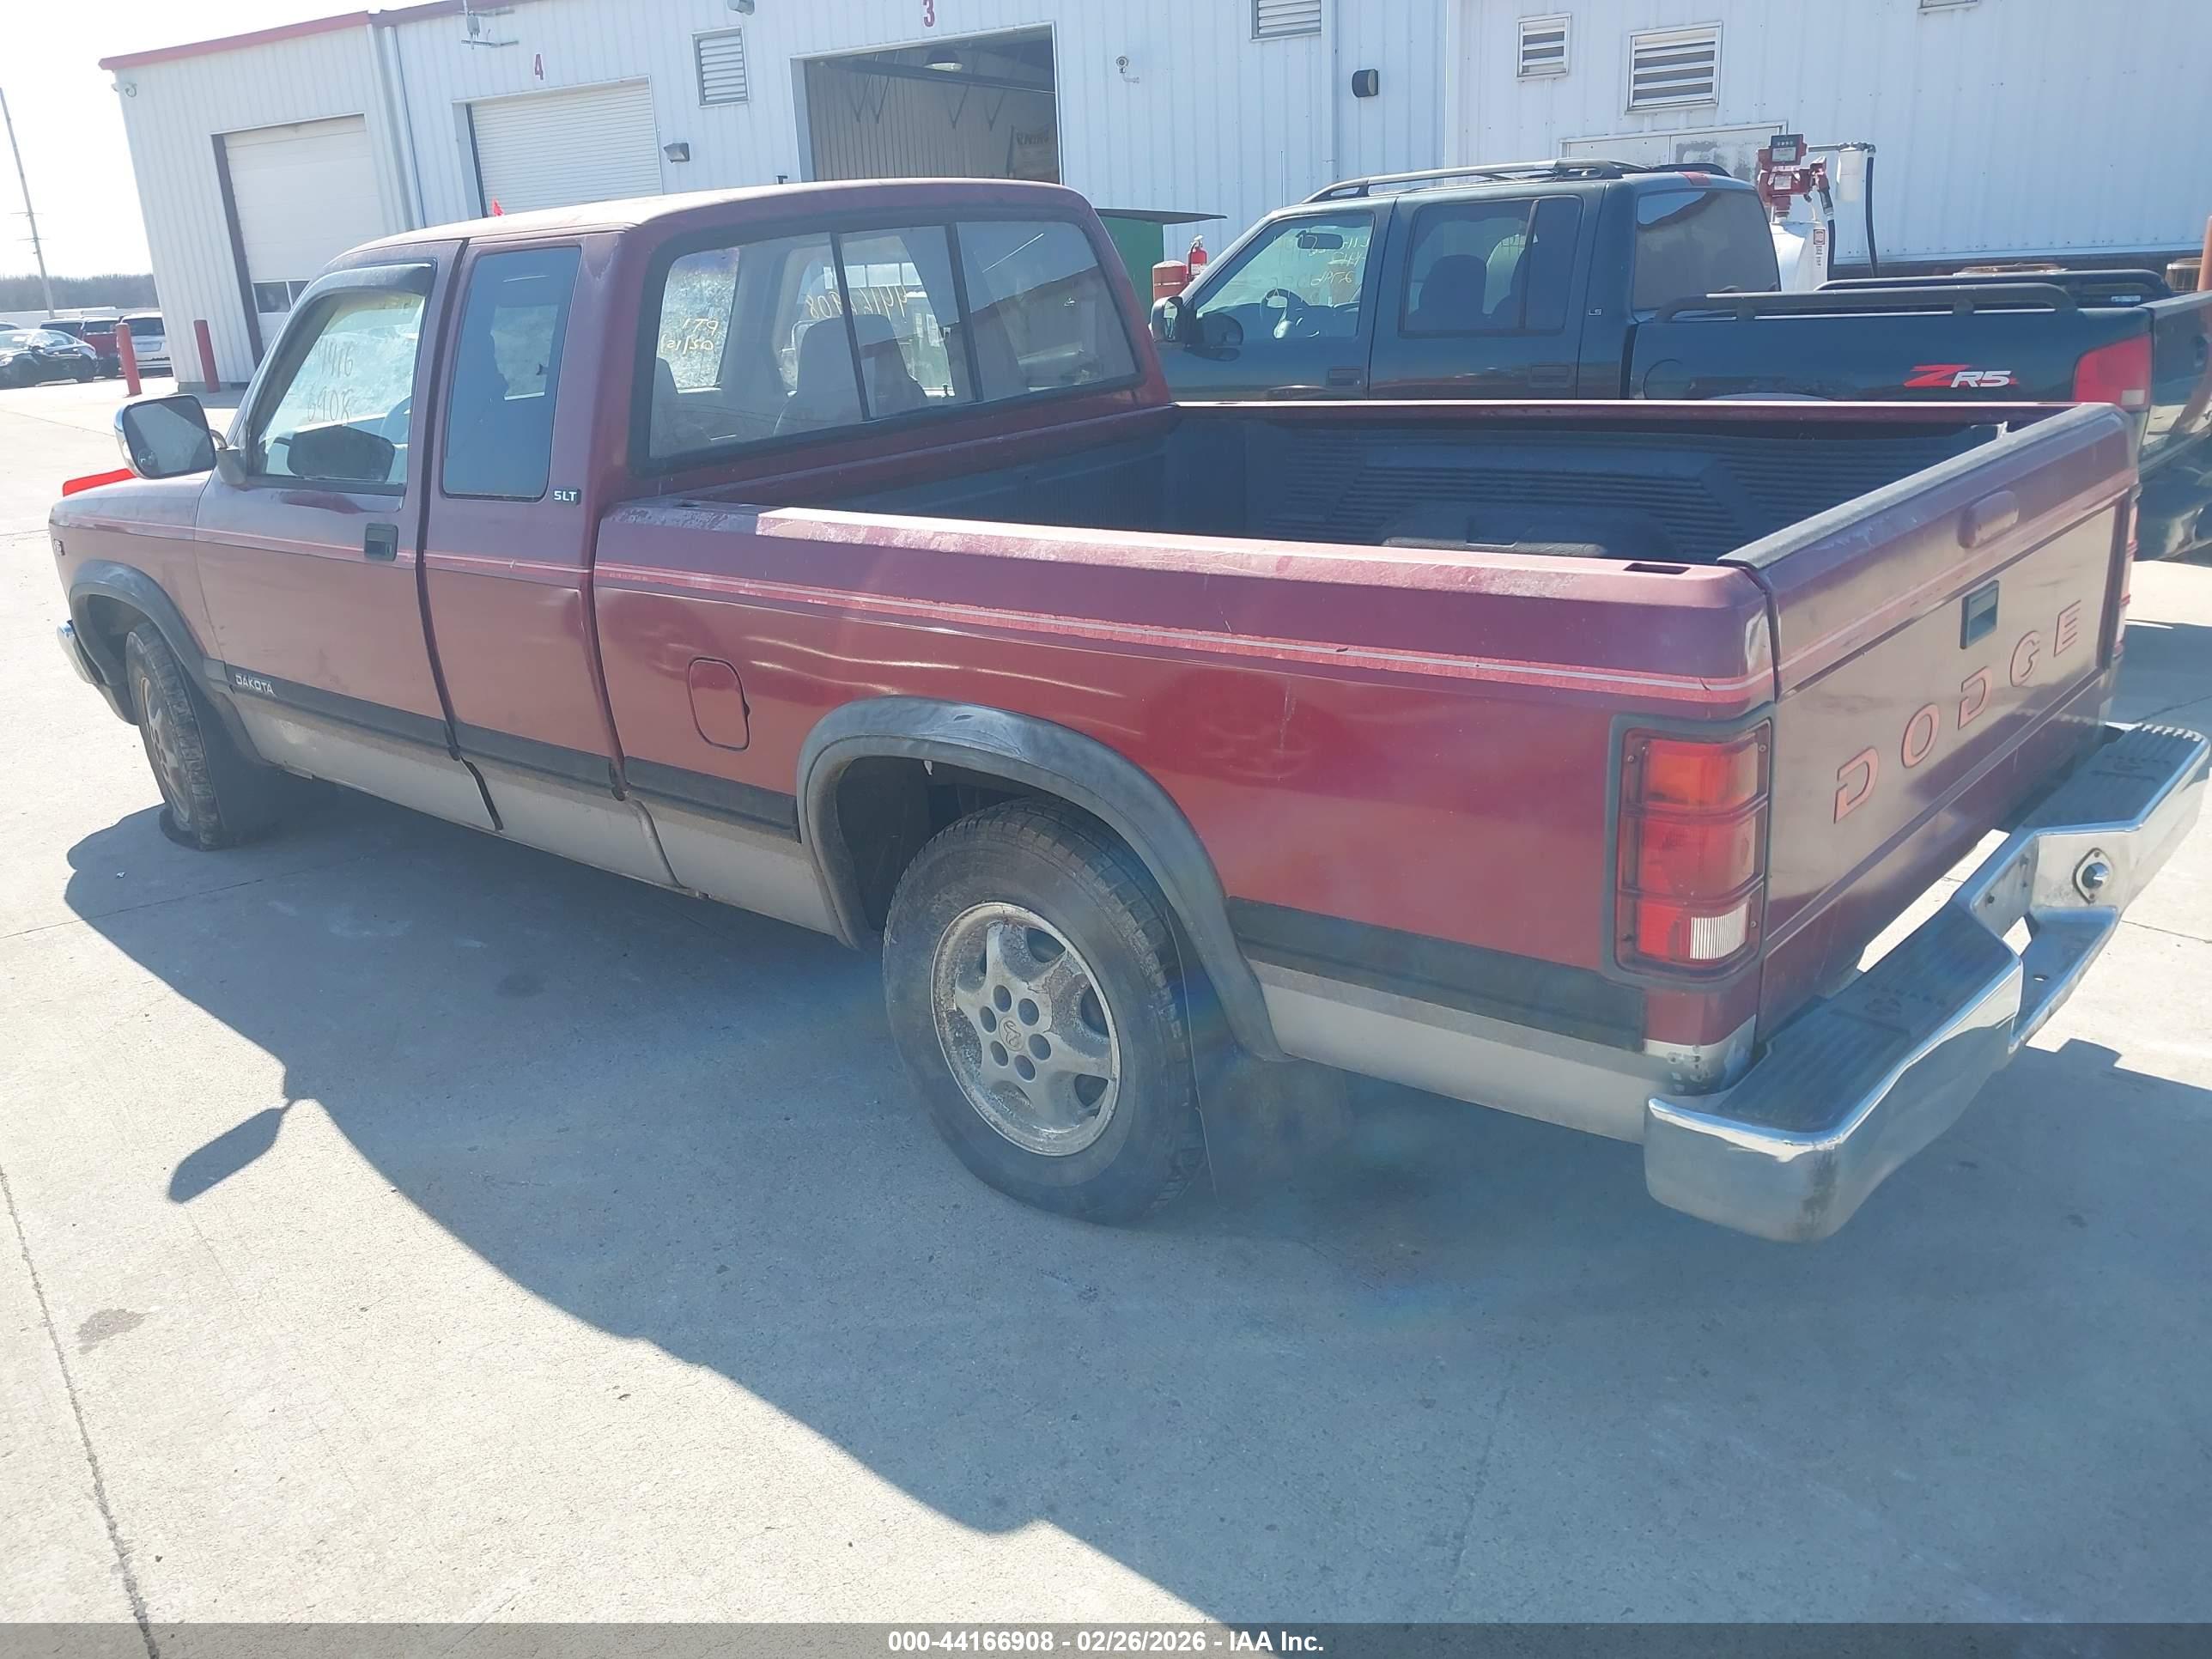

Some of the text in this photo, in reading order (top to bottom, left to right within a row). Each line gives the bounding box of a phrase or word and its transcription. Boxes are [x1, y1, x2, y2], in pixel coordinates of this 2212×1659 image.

[922, 0, 935, 27] 3
[534, 53, 544, 81] 4
[1904, 364, 2014, 387] ZR5
[554, 490, 577, 501] SLT
[235, 674, 274, 695] DAKOTA
[1833, 599, 2081, 824] DODGE
